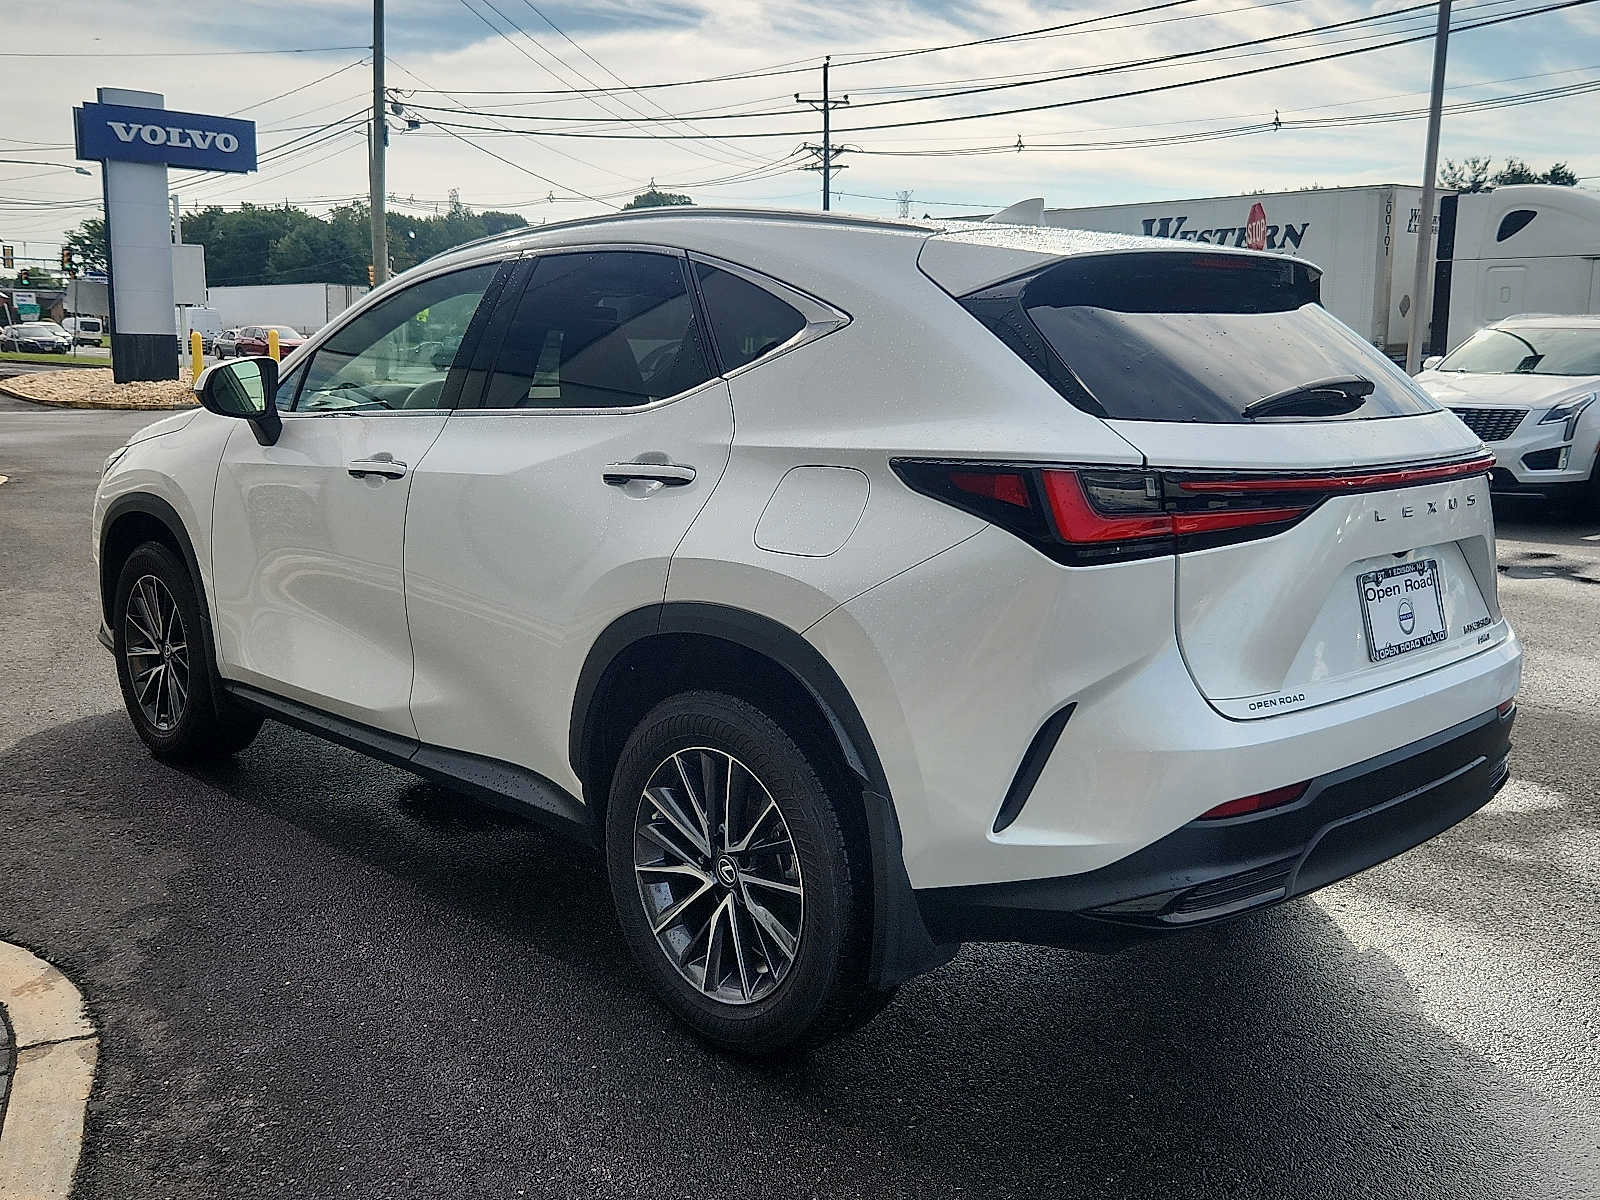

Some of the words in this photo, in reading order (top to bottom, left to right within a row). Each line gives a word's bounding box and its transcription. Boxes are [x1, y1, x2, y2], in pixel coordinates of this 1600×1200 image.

[107, 121, 239, 153] VOLVO
[1248, 219, 1265, 245] STOP
[1374, 494, 1476, 522] LEXUS
[1366, 584, 1401, 603] Open
[1404, 573, 1433, 593] Road
[1379, 645, 1400, 659] OPEN
[1400, 639, 1421, 653] ROAD
[1421, 632, 1445, 646] VOLVO
[1248, 699, 1277, 710] OPEN
[1279, 693, 1305, 705] ROAD
